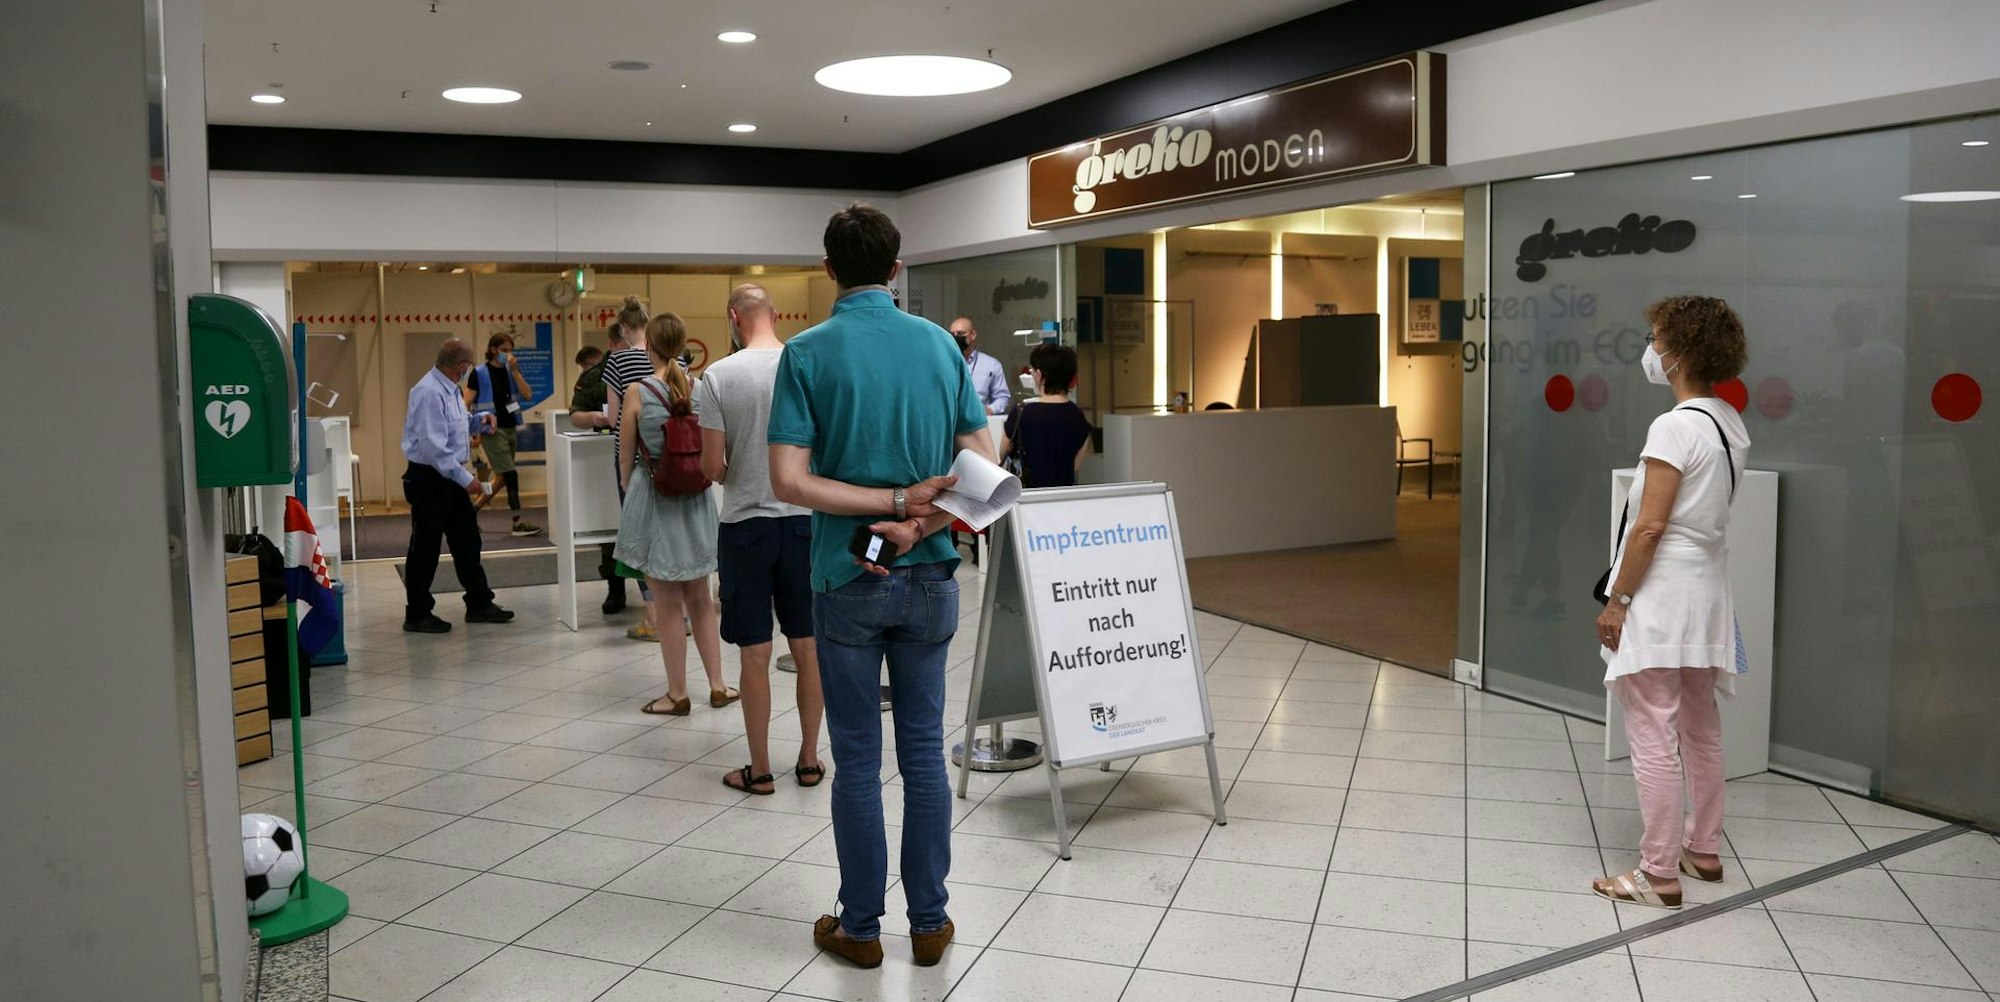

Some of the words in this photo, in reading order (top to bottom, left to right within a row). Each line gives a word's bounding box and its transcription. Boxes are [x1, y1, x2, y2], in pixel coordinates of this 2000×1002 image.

[1073, 126, 1212, 213] greko
[1516, 213, 1696, 282] greko
[1551, 284, 1597, 318] Sie
[1545, 329, 1581, 364] im
[205, 384, 250, 395] AED
[1027, 523, 1168, 554] Impfzentrum
[1052, 577, 1122, 603] Eintritt
[1126, 576, 1158, 595] nur
[1088, 607, 1135, 632] nach
[1049, 634, 1187, 672] Aufforderung!
